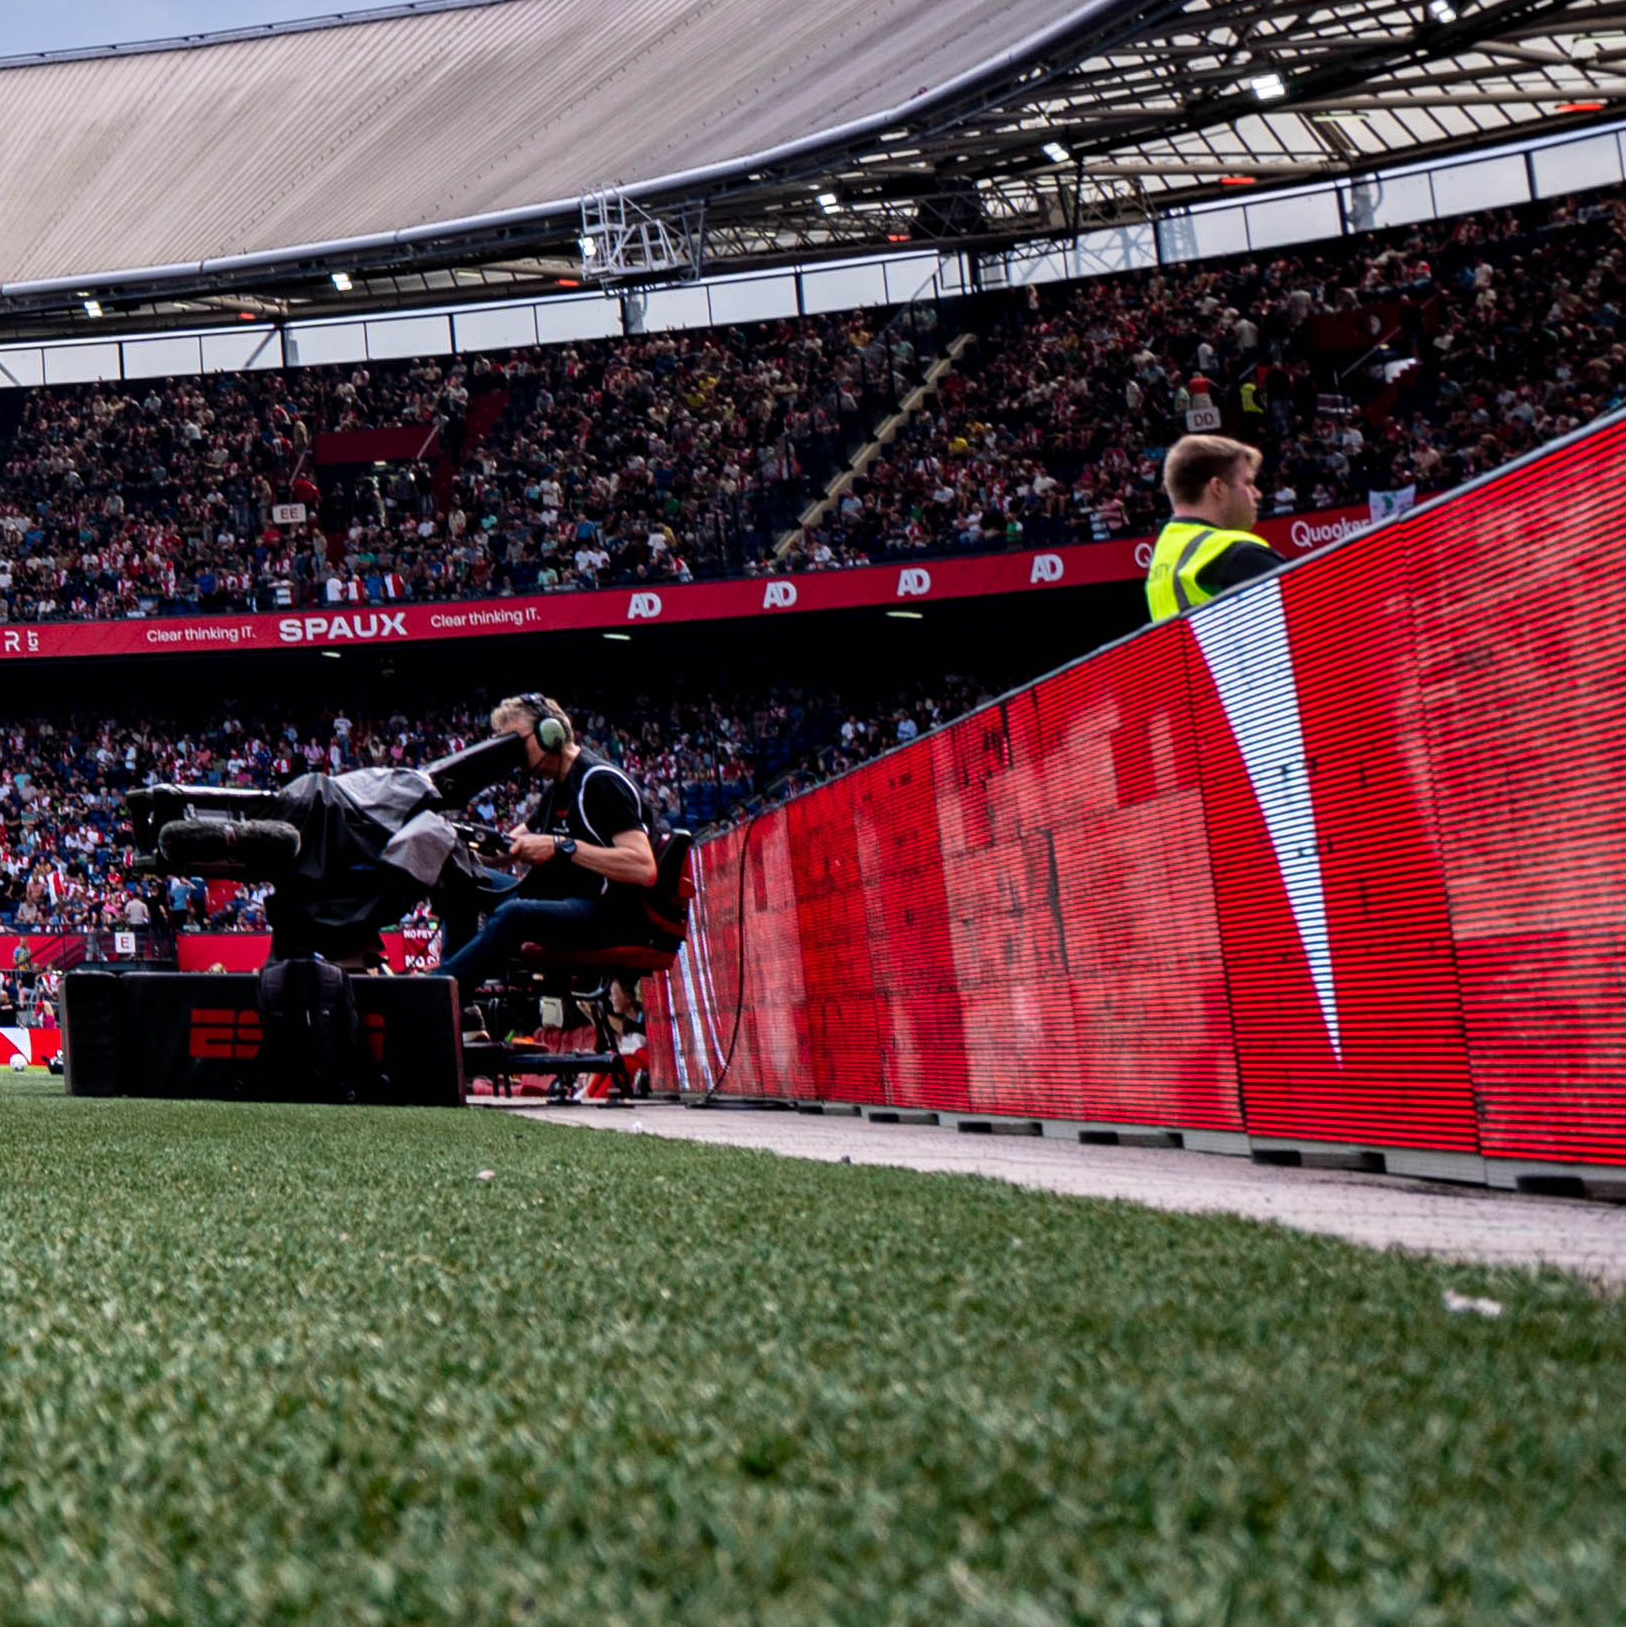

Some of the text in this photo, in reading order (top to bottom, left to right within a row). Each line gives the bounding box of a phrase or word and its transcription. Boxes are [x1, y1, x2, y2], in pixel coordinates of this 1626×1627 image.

[1193, 413, 1214, 427] DD
[280, 507, 299, 520] EE
[1030, 554, 1064, 584] AD
[897, 568, 931, 597] AD
[627, 592, 662, 619] AD
[763, 581, 797, 609] AD
[279, 613, 407, 642] SPAUX
[430, 613, 466, 628] Clear
[469, 608, 523, 625] thinking
[147, 629, 181, 643] Clear
[185, 625, 238, 643] thinking
[120, 936, 130, 949] E
